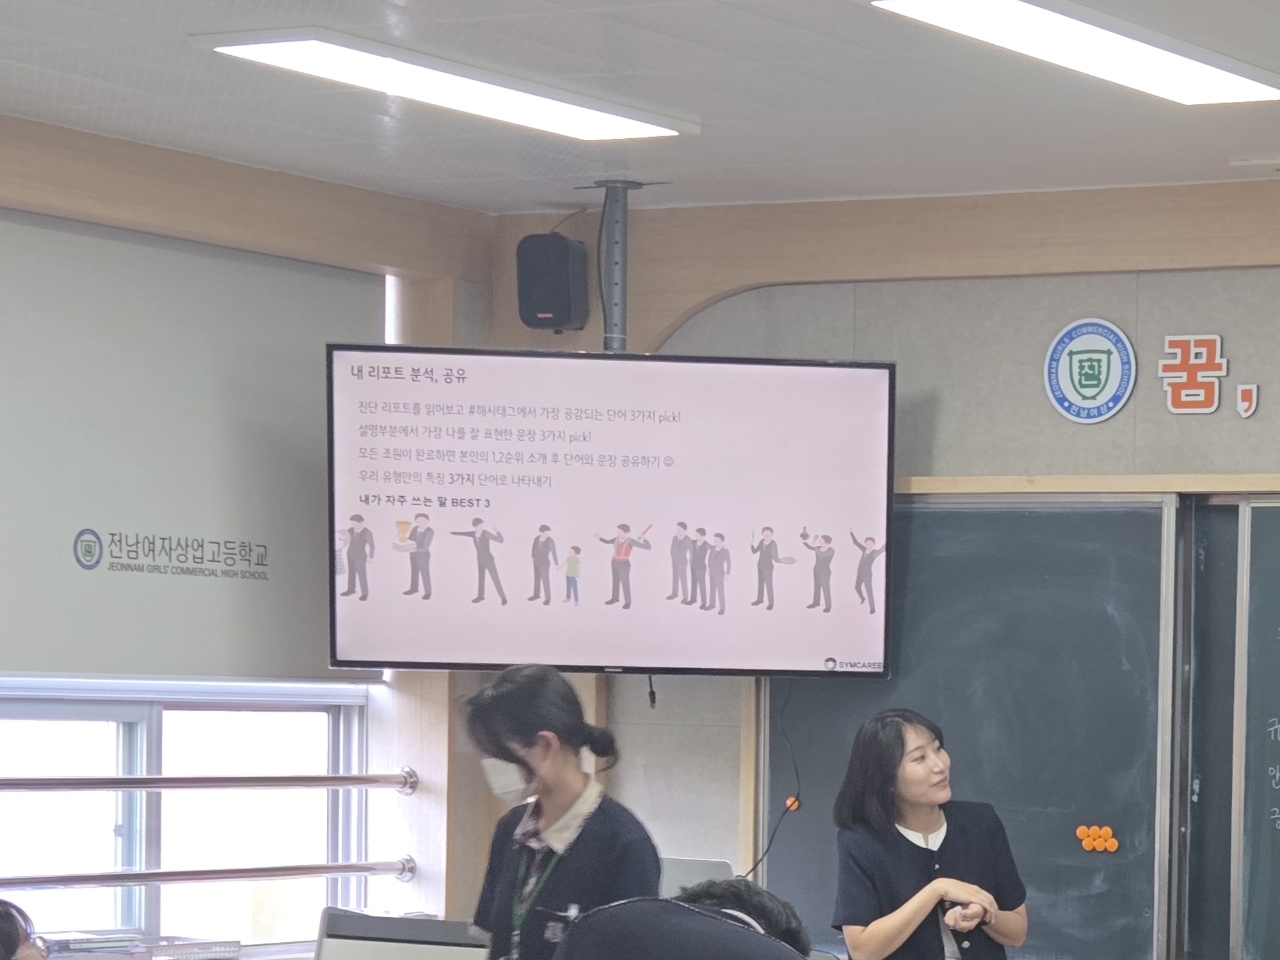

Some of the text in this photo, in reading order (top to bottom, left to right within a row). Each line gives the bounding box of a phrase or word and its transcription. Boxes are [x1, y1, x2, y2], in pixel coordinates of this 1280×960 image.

[1071, 326, 1118, 344] COMMERCIAL
[1115, 342, 1127, 363] HIGH
[351, 365, 364, 380] 내
[368, 365, 406, 380] 리포트
[442, 368, 467, 384] 공유
[1050, 361, 1064, 399] JEONNAM
[1116, 364, 1130, 397] SCHOOL
[1158, 334, 1259, 419] 꿈,
[358, 401, 681, 425] 진단 리포트를 읽어보고 #해시태그에서 가장 공감되는 단어 3가지 pick!
[1069, 404, 1108, 418] 전남여상
[358, 424, 592, 444] 설명부분에서 가장 나를 잘 표현한 문장 3가지 pick!
[358, 447, 379, 460] 모든
[382, 448, 412, 461] 조원이
[415, 449, 456, 462] 완료하면
[459, 450, 489, 463] 본인의
[526, 452, 547, 465] 소개
[550, 452, 561, 465] 후
[564, 453, 594, 466] 단어와
[597, 454, 617, 467] 문장
[620, 455, 661, 468] 공유하기
[358, 470, 552, 488] 우리 유형만의 특징 3가지 단어로 나타내기
[359, 494, 382, 506] 내가
[385, 495, 407, 506] 자주
[411, 496, 433, 507] 쓰는
[451, 498, 481, 508] BEST
[484, 499, 491, 508] 3
[108, 532, 269, 568] 전남여자상업고등학교
[107, 562, 145, 573] JEONNAM
[171, 566, 219, 578] COMMERCIAL
[221, 569, 239, 579] HIGH
[240, 570, 270, 581] SCHOOL
